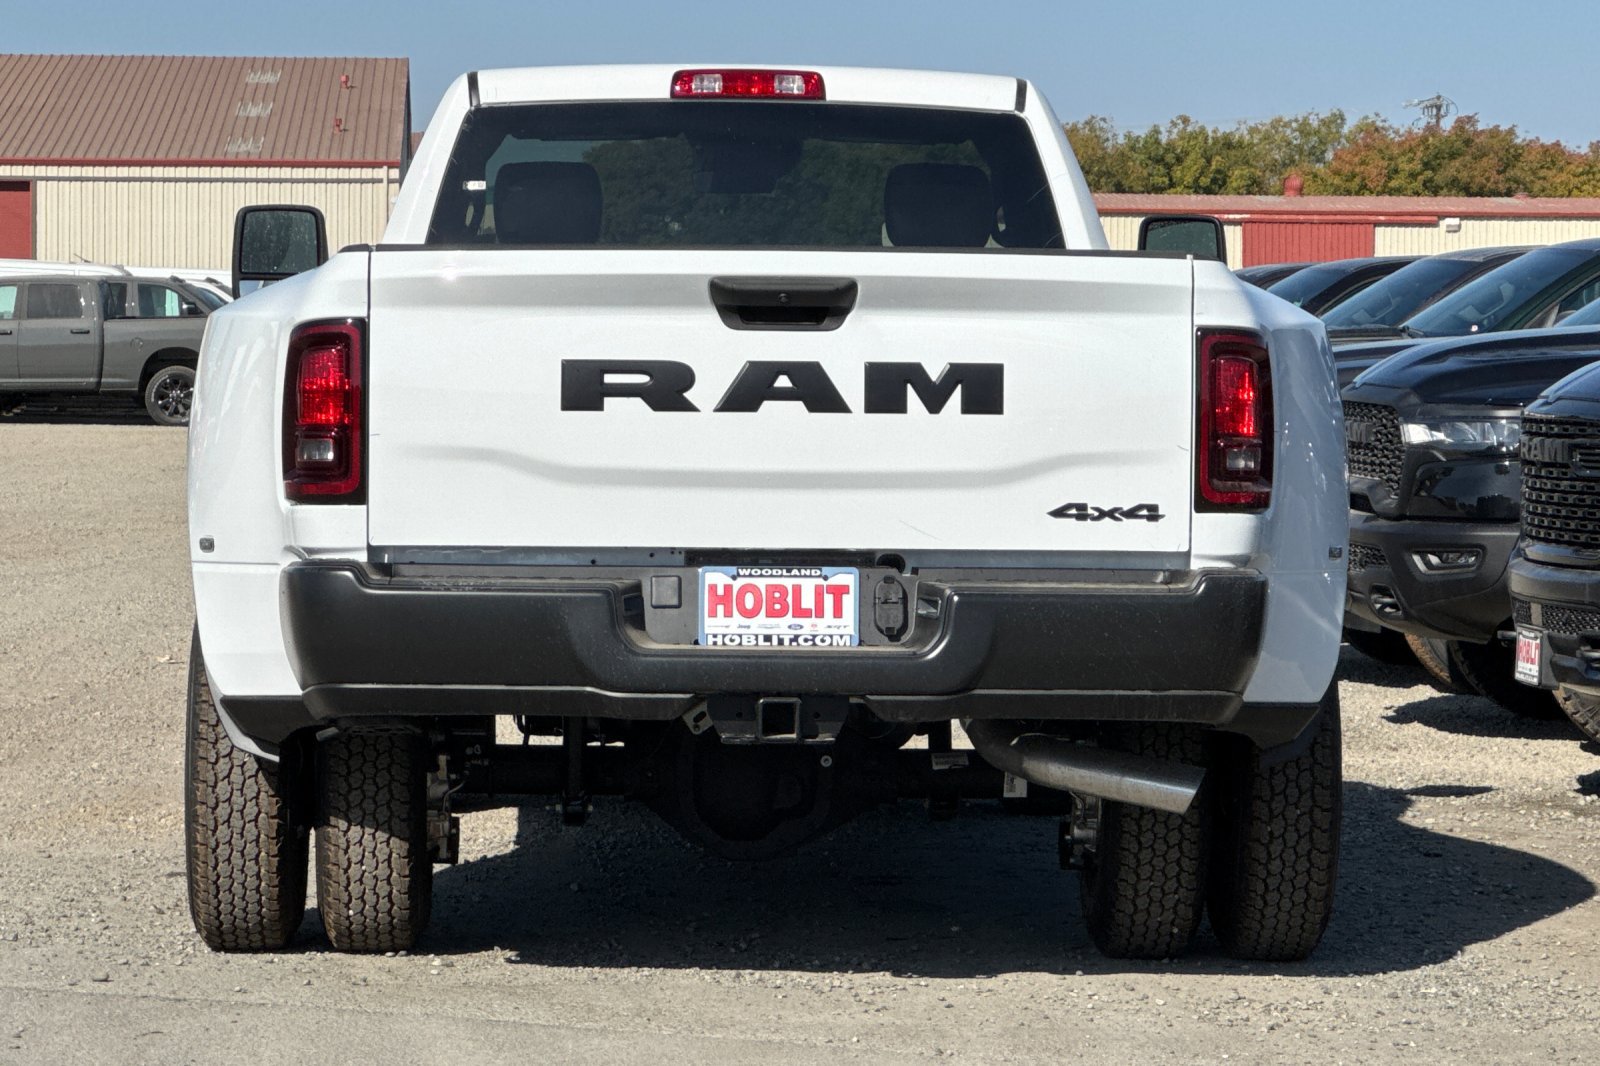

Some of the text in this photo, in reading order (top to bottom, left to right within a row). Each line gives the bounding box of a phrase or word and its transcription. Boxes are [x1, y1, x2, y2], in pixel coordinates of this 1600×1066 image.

[561, 358, 1005, 415] RAM
[1520, 436, 1568, 461] RAM
[1046, 502, 1166, 522] 4x4
[738, 568, 821, 576] WOODLAND
[707, 583, 850, 619] HOBLIT
[707, 634, 850, 646] HOBLIT.COM
